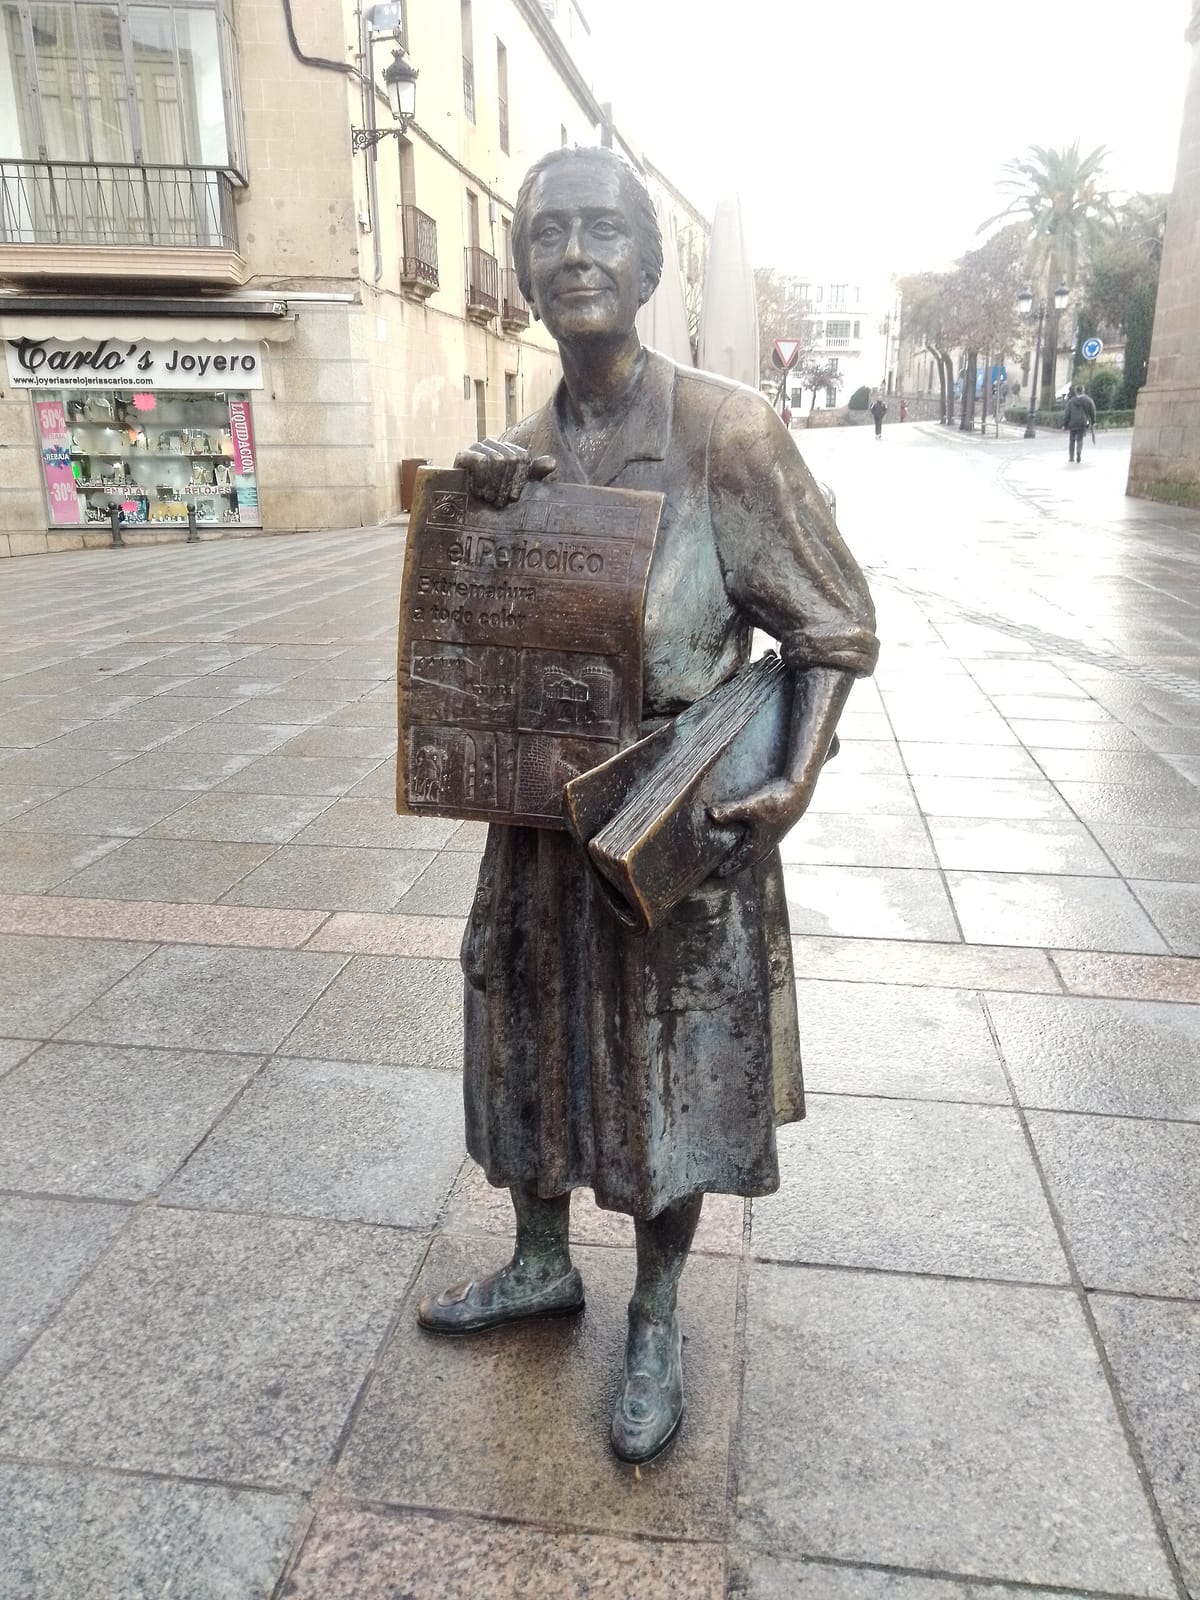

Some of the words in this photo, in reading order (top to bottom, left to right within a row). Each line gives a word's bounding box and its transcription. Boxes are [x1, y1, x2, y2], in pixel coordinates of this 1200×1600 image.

[165, 350, 256, 376] Joyero
[13, 376, 153, 386] www.joyeriasrelojeriascarlos.com
[417, 575, 537, 600] Extremadura
[412, 606, 426, 623] a
[431, 604, 474, 625] todo
